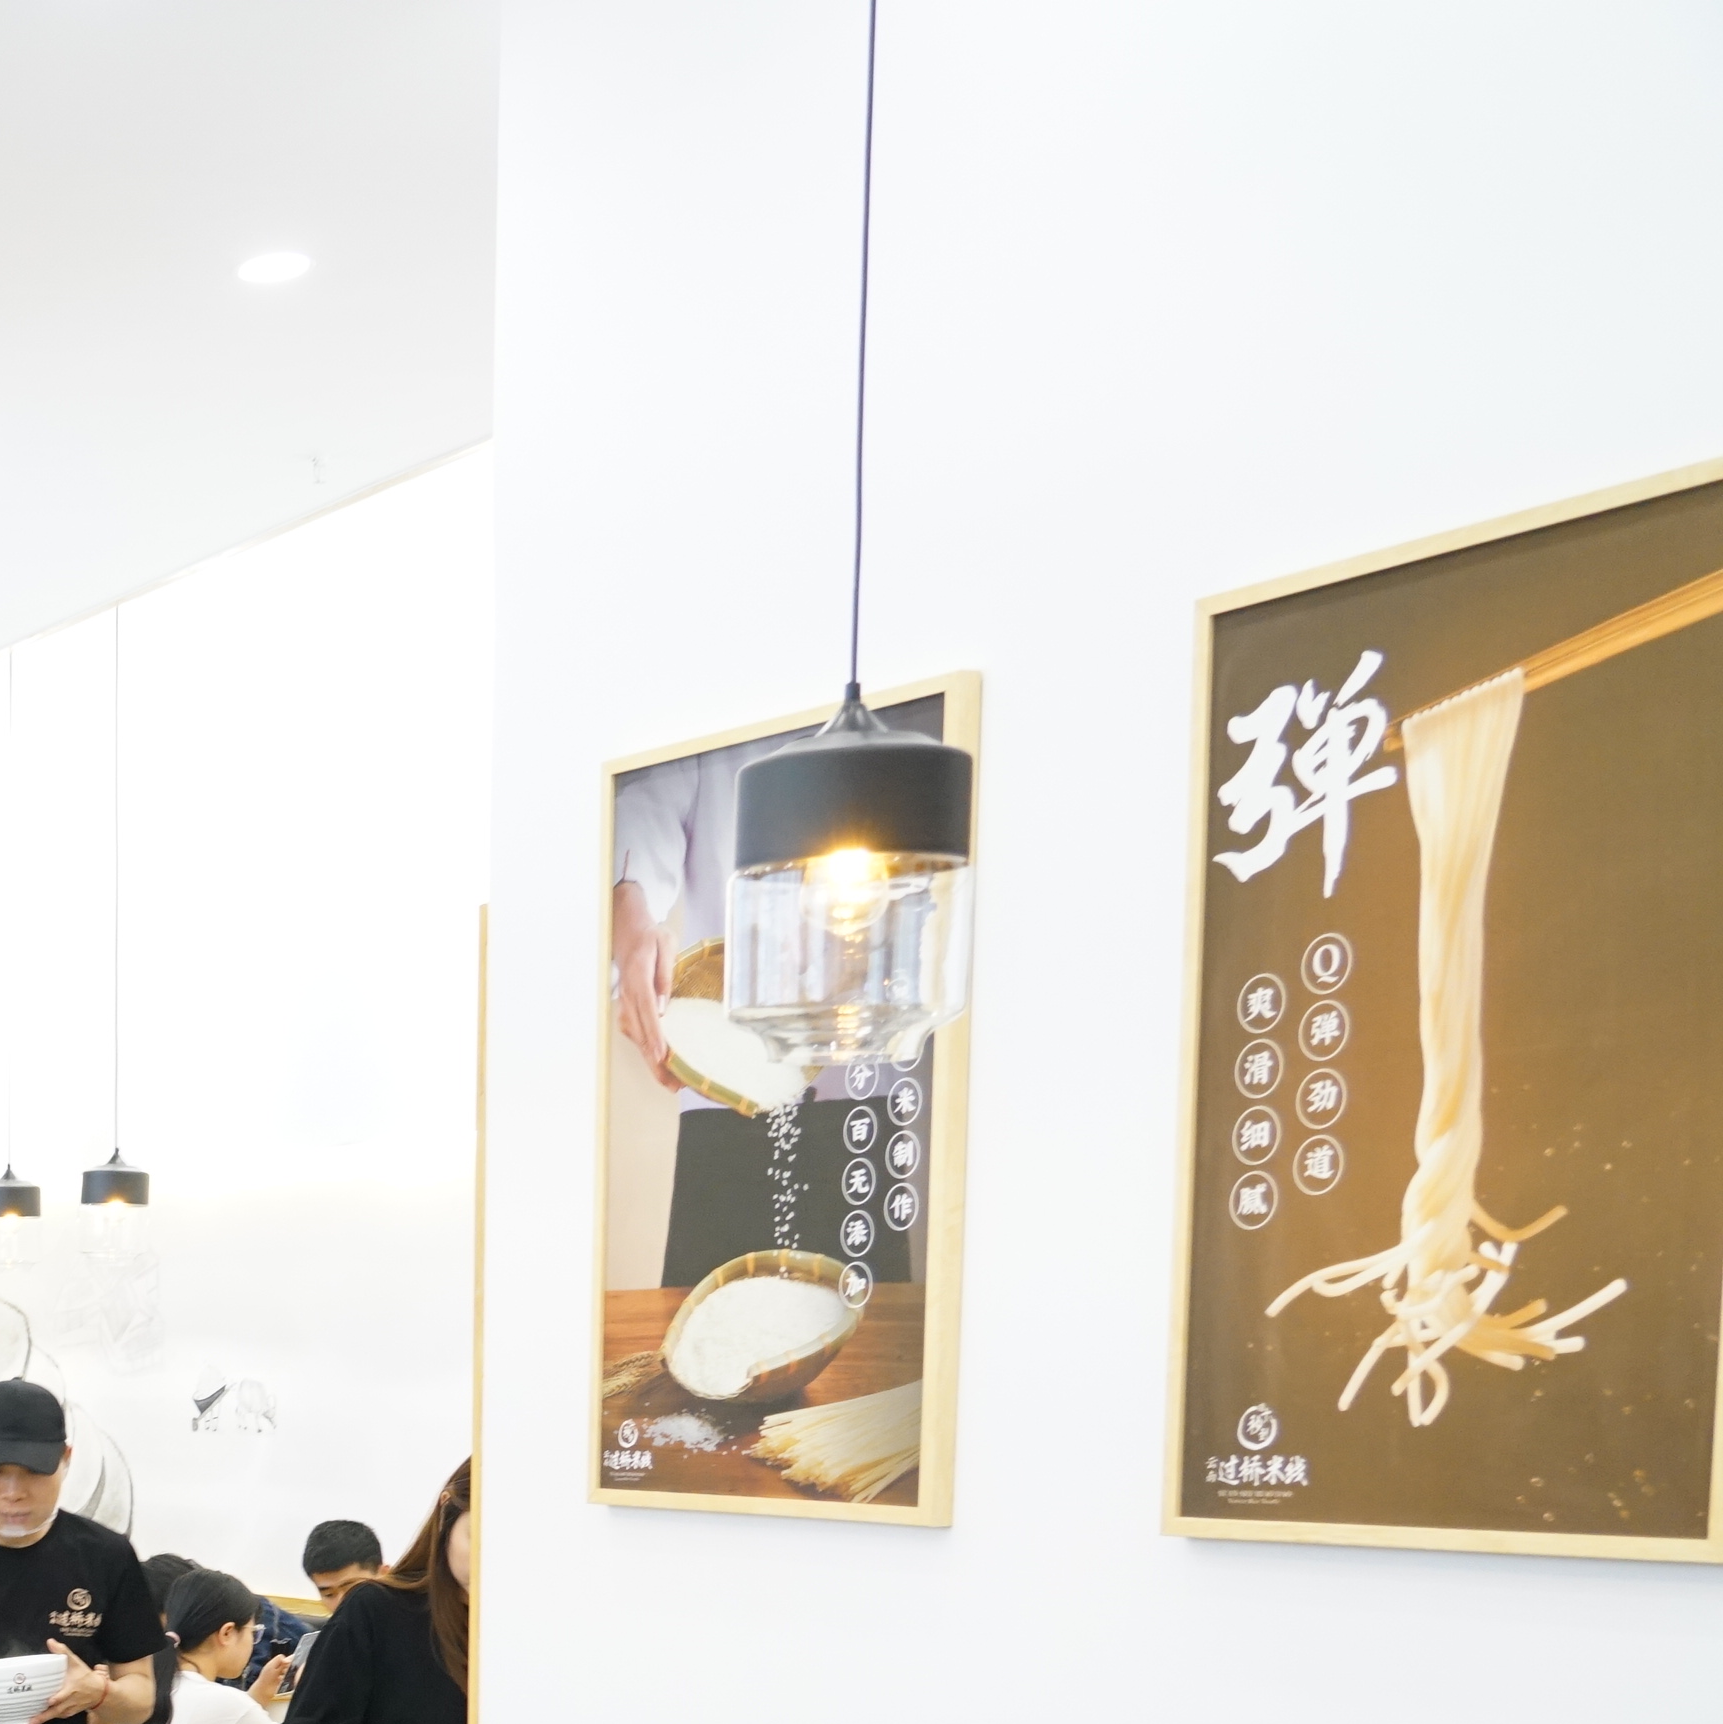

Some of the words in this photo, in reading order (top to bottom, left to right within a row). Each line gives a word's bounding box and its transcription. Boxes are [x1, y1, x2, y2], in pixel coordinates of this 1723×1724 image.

[1236, 986, 1277, 1216] 爽滑细腻
[1304, 943, 1341, 1180] Q弹劲道
